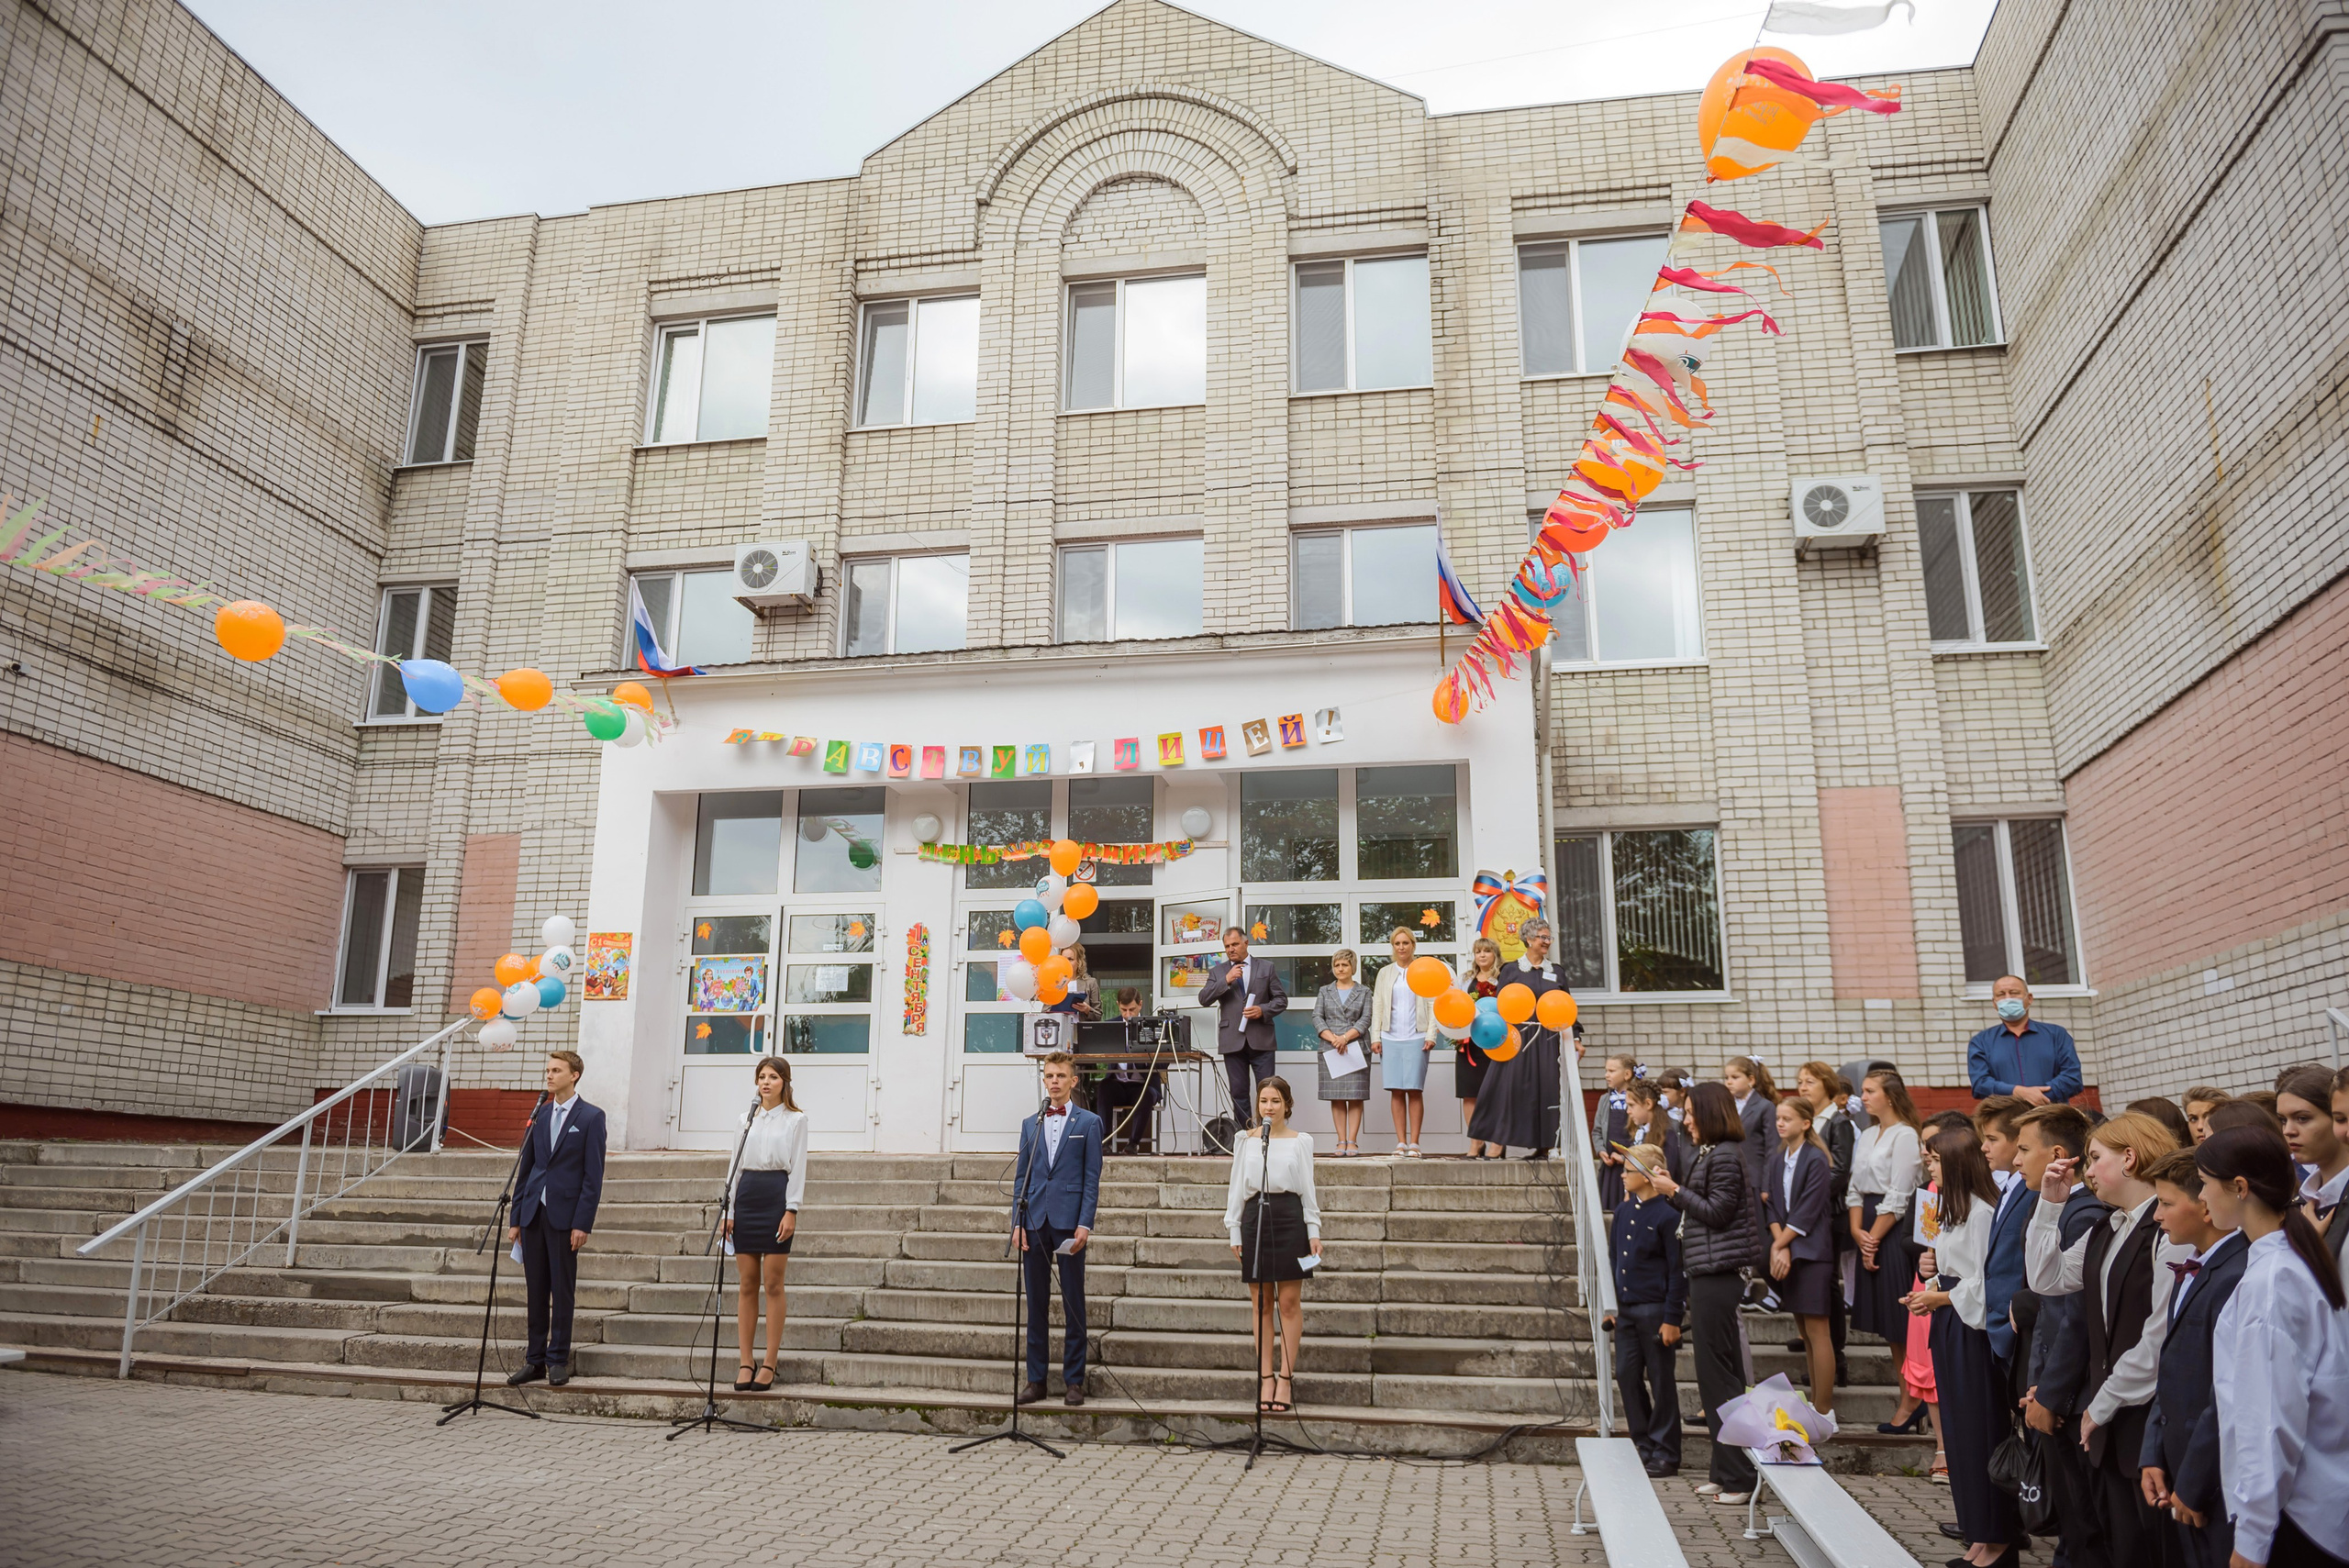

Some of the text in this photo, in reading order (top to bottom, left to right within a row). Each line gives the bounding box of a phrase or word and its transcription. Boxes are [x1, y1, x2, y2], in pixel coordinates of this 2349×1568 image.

[1115, 709, 1336, 765] ЛИЦЕЙ!
[918, 839, 1175, 865] ДЕНЬ ЗАНИЙ!
[913, 922, 923, 942] 1
[907, 945, 926, 1033] СЕНТЯБРЯ
